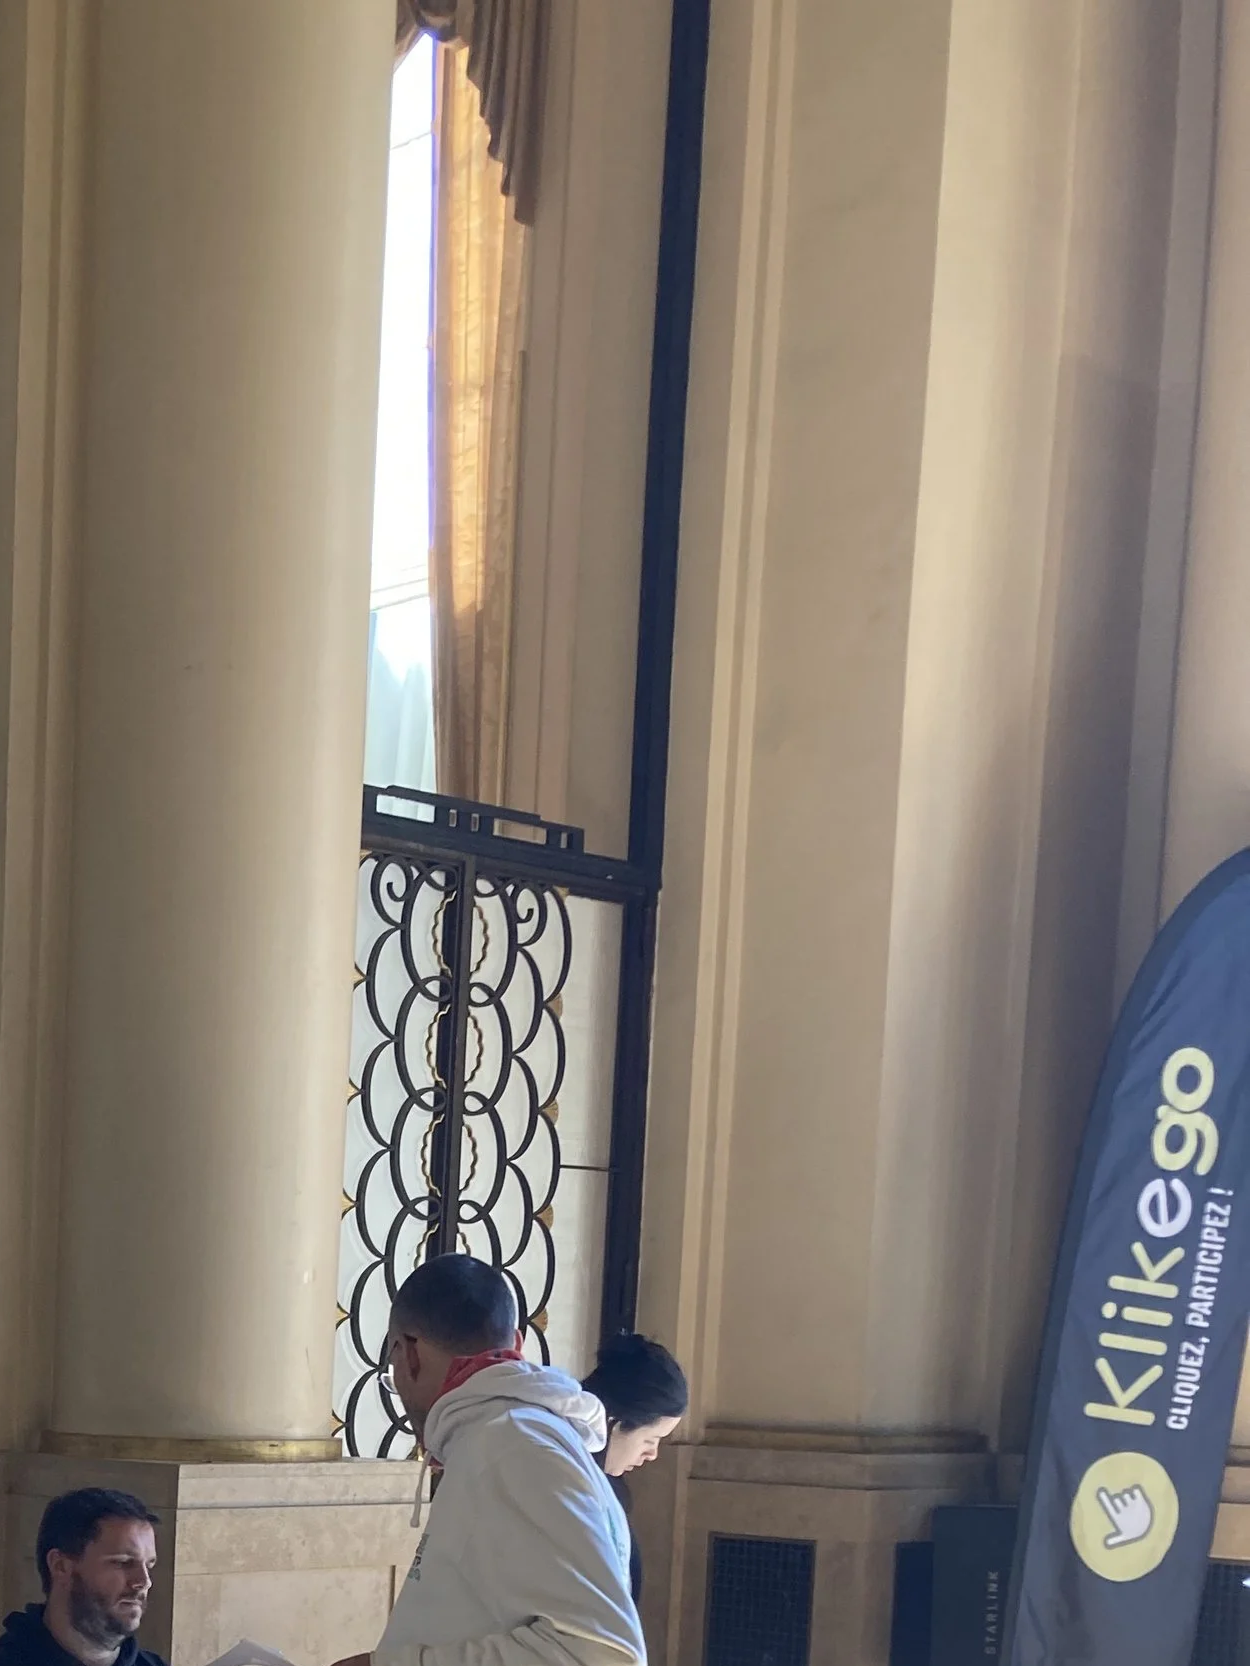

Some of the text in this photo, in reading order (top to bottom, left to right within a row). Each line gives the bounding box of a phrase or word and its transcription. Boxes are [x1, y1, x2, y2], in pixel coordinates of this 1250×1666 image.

[1083, 1047, 1219, 1426] Klikego
[1184, 1201, 1232, 1329] PARTICIPEZ
[1166, 1336, 1211, 1431] CLIQUEZ,
